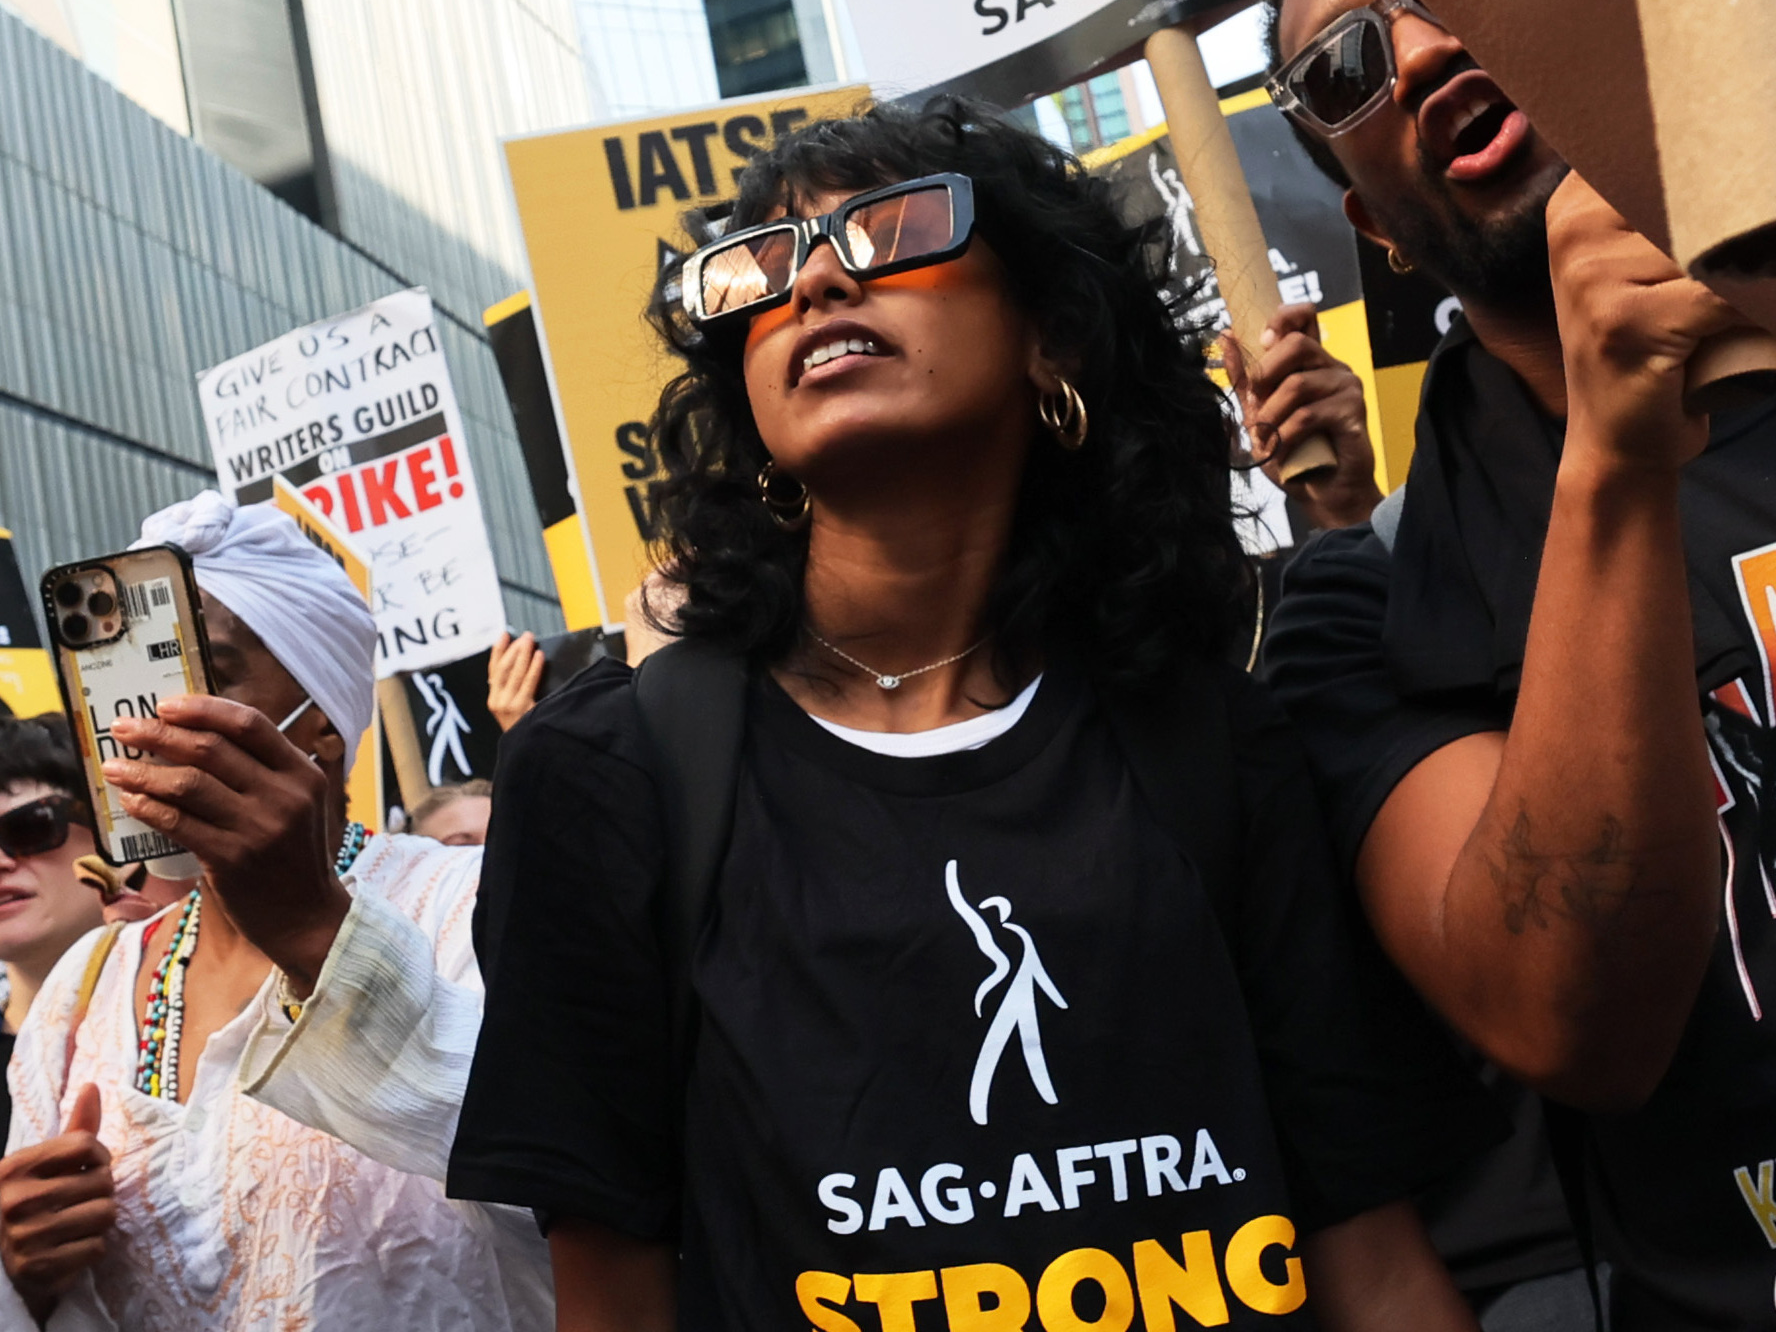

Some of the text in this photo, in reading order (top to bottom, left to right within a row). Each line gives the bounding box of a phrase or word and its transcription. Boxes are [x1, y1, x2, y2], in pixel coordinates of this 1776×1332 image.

[215, 314, 392, 400] GIVE US A
[215, 396, 278, 445] FAIR
[228, 382, 440, 482] WRITERS GUILD
[318, 445, 353, 475] ON
[148, 638, 181, 662] LHR
